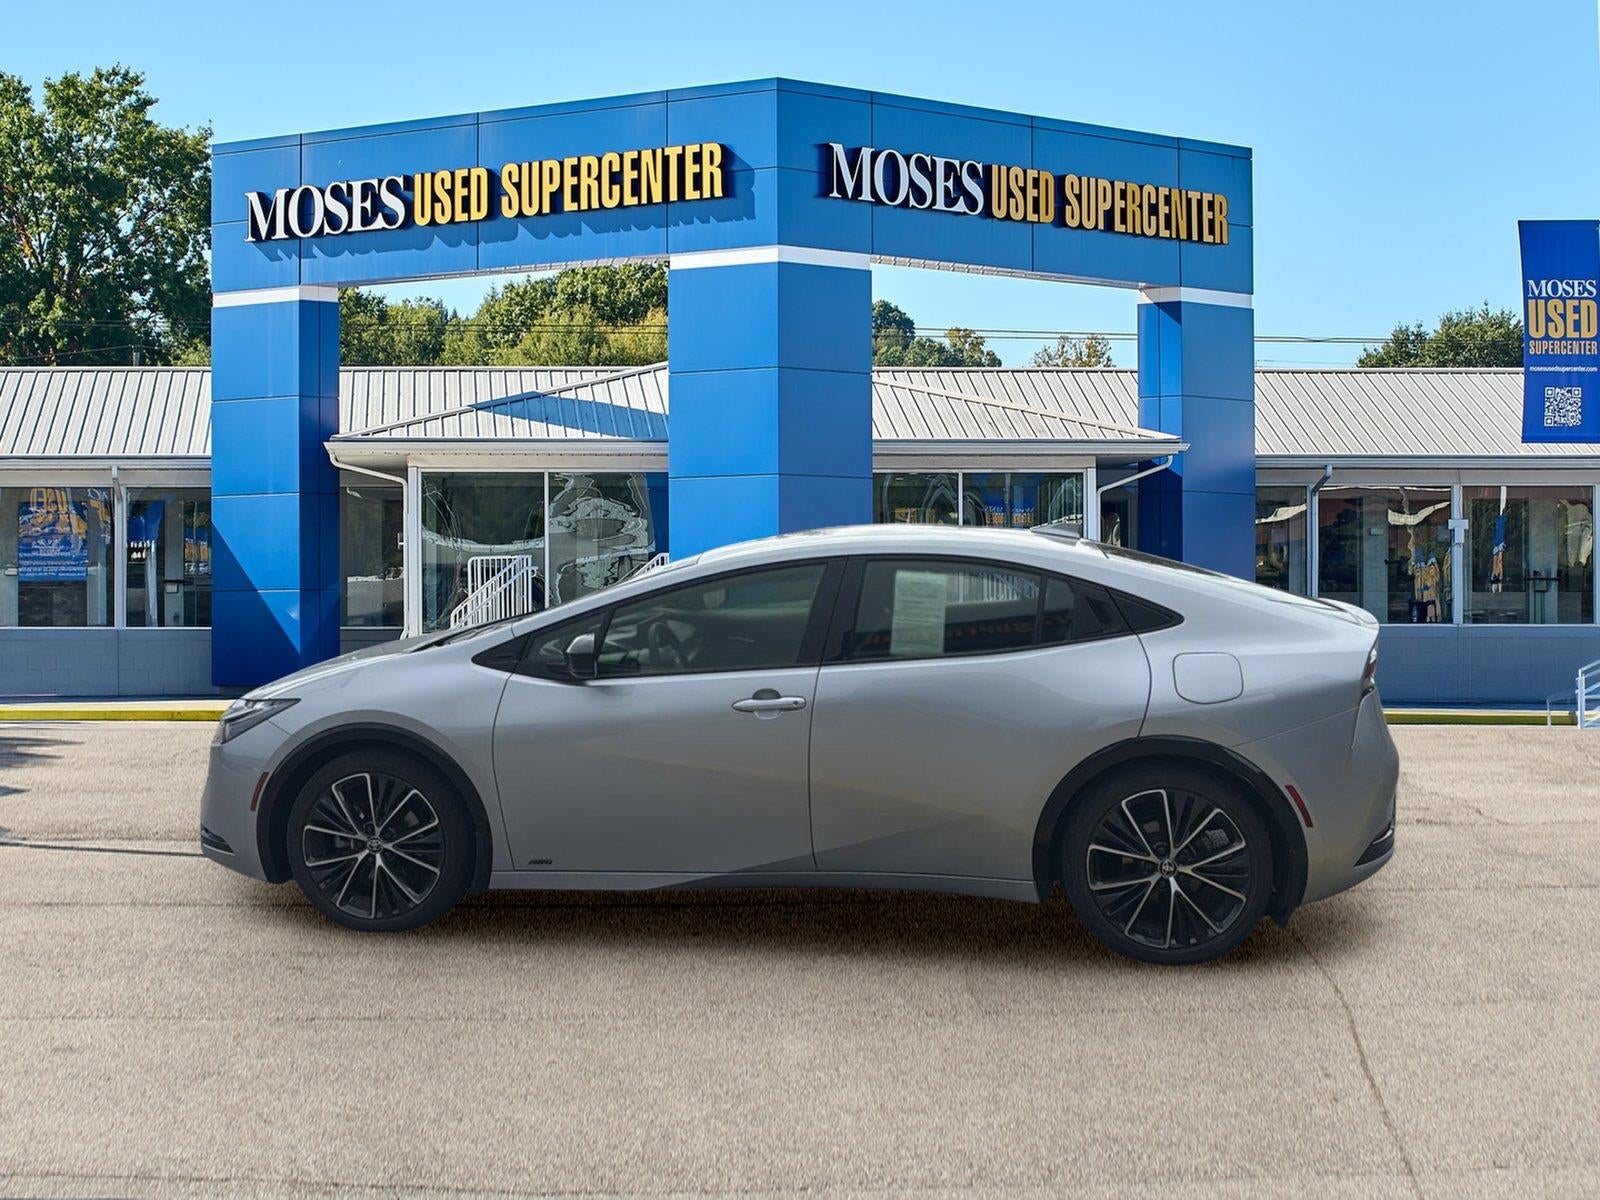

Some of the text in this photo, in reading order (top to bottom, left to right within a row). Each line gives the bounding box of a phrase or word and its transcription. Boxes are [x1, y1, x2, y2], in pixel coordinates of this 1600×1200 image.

[244, 142, 724, 243] MOSES USED SUPERCENTER
[828, 142, 1229, 245] MOSES USED SUPERCENTER
[1527, 279, 1597, 298] MOSES
[1528, 299, 1598, 339] USED
[1529, 340, 1598, 355] SUPERCENTER
